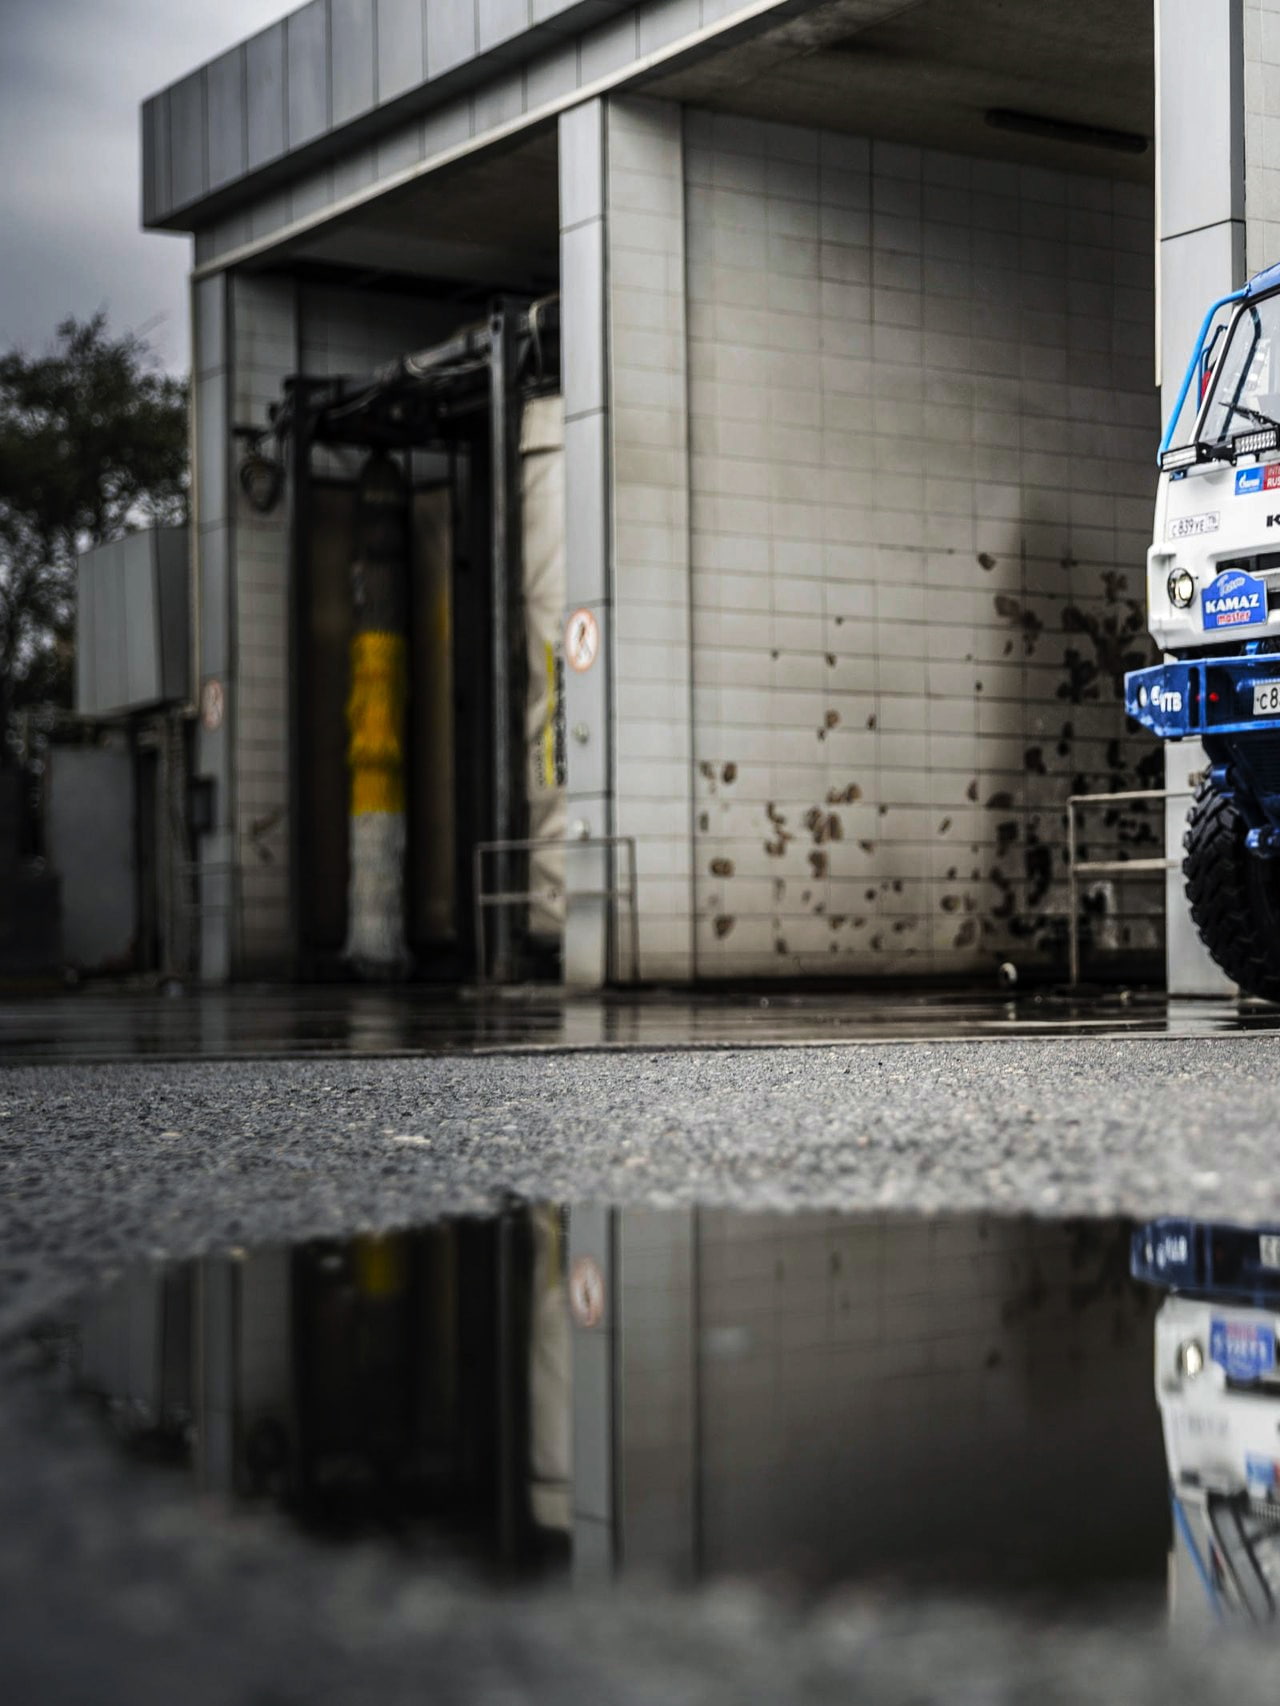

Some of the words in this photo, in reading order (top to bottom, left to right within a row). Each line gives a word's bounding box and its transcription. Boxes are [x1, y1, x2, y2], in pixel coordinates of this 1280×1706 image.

[1205, 594, 1260, 614] KAMAZ
[1217, 610, 1251, 625] master
[1160, 691, 1182, 713] VTB
